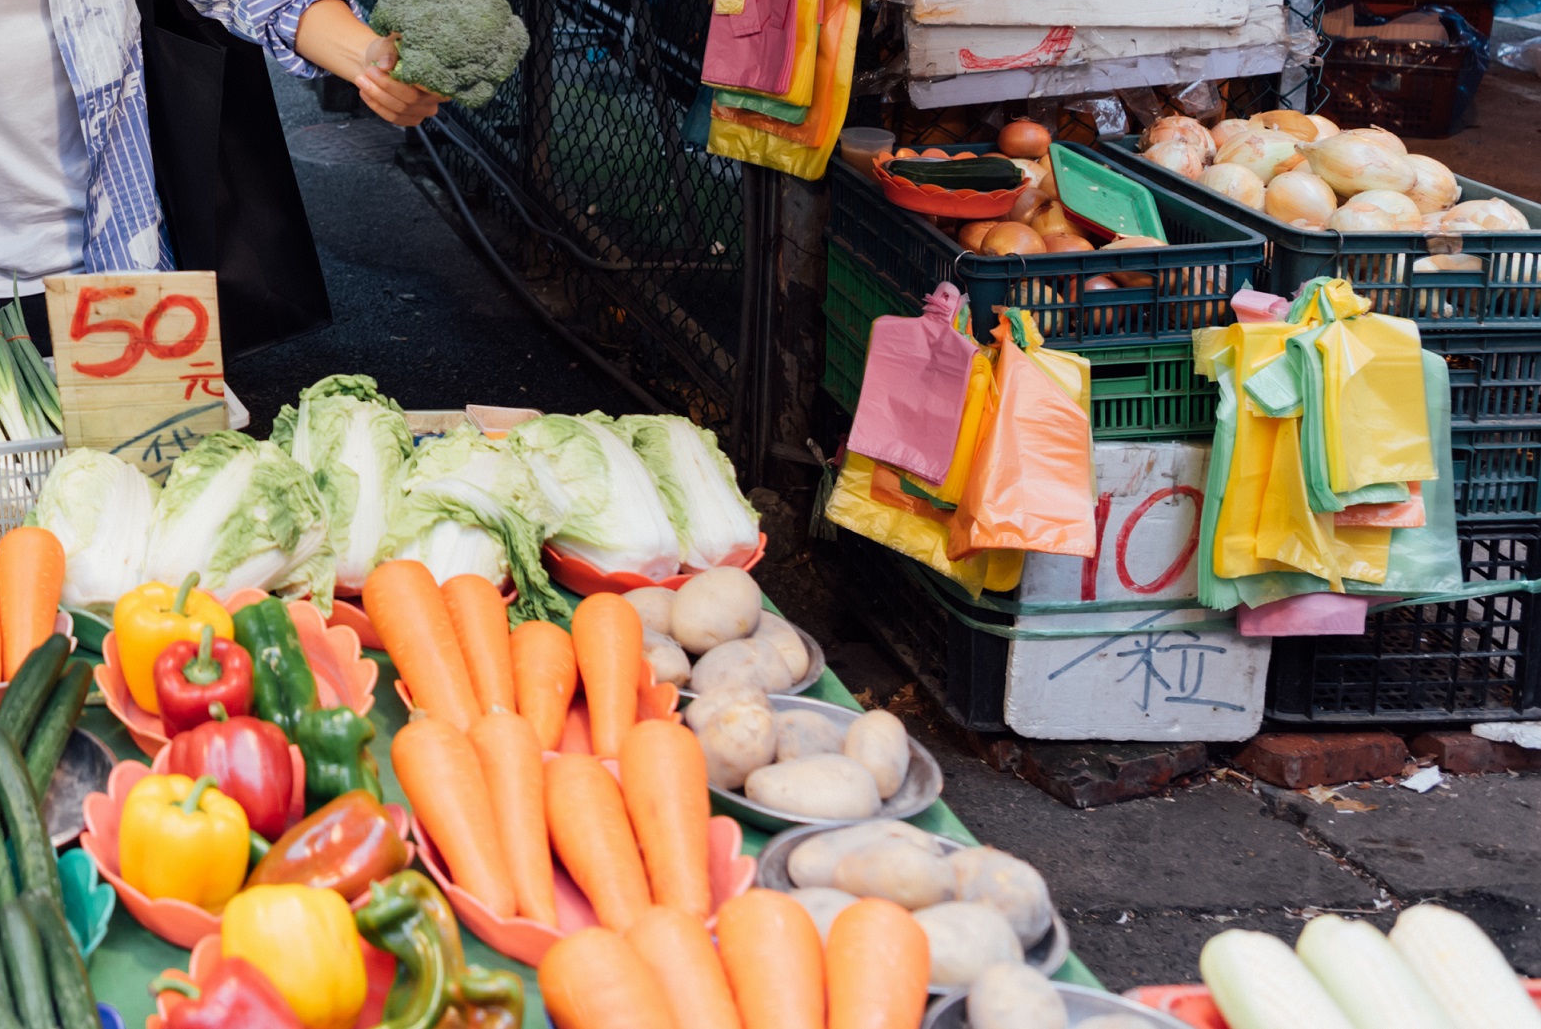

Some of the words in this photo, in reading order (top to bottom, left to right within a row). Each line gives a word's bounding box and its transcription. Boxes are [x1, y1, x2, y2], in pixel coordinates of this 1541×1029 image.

[70, 285, 210, 379] 50
[179, 361, 225, 400] 元
[1080, 485, 1204, 601] 10
